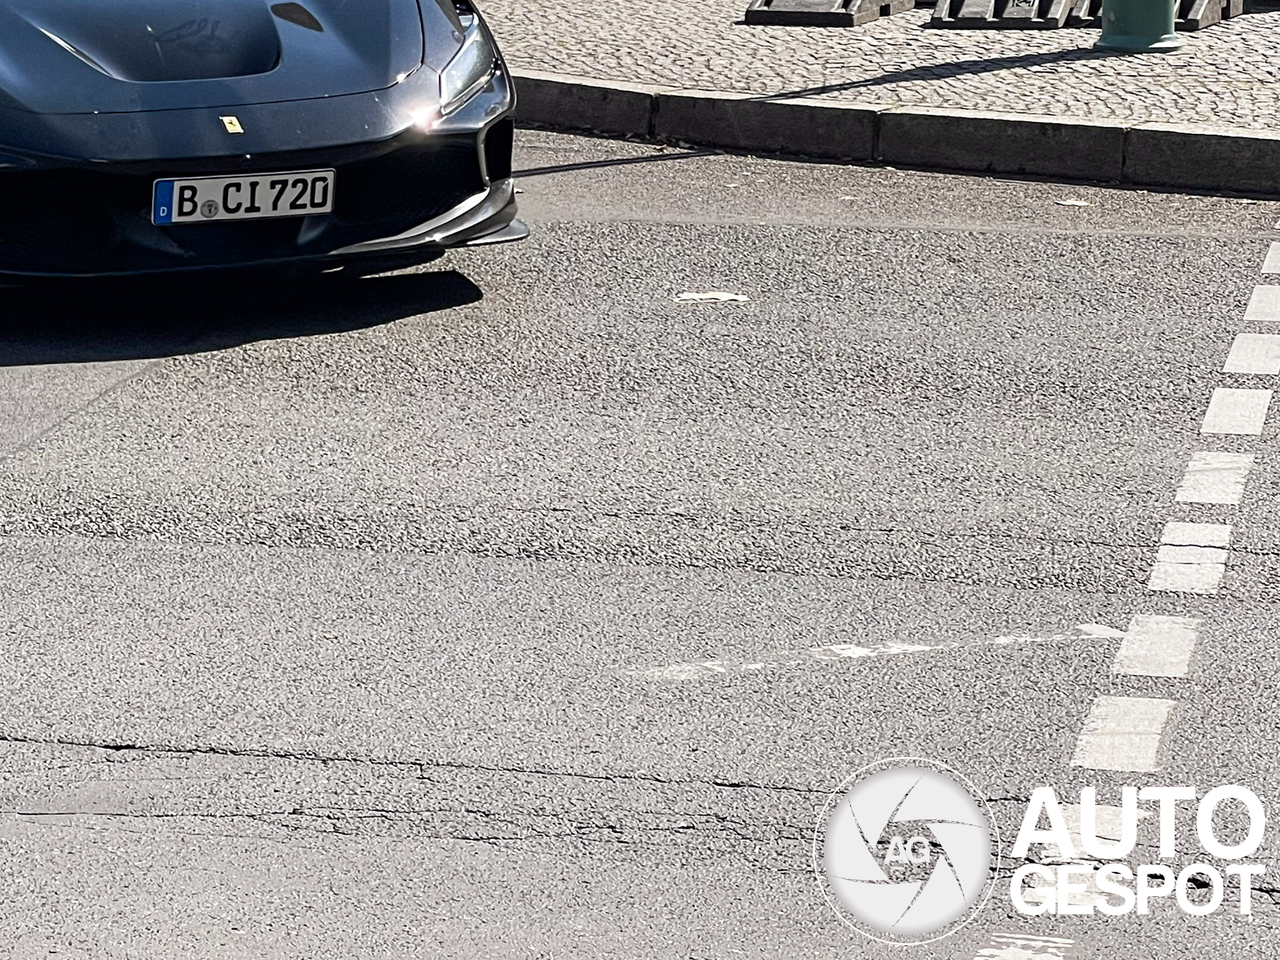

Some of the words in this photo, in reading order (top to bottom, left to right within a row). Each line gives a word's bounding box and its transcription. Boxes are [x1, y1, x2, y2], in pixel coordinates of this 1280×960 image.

[177, 185, 198, 217] B
[222, 181, 261, 215] CI
[269, 176, 329, 211] 720
